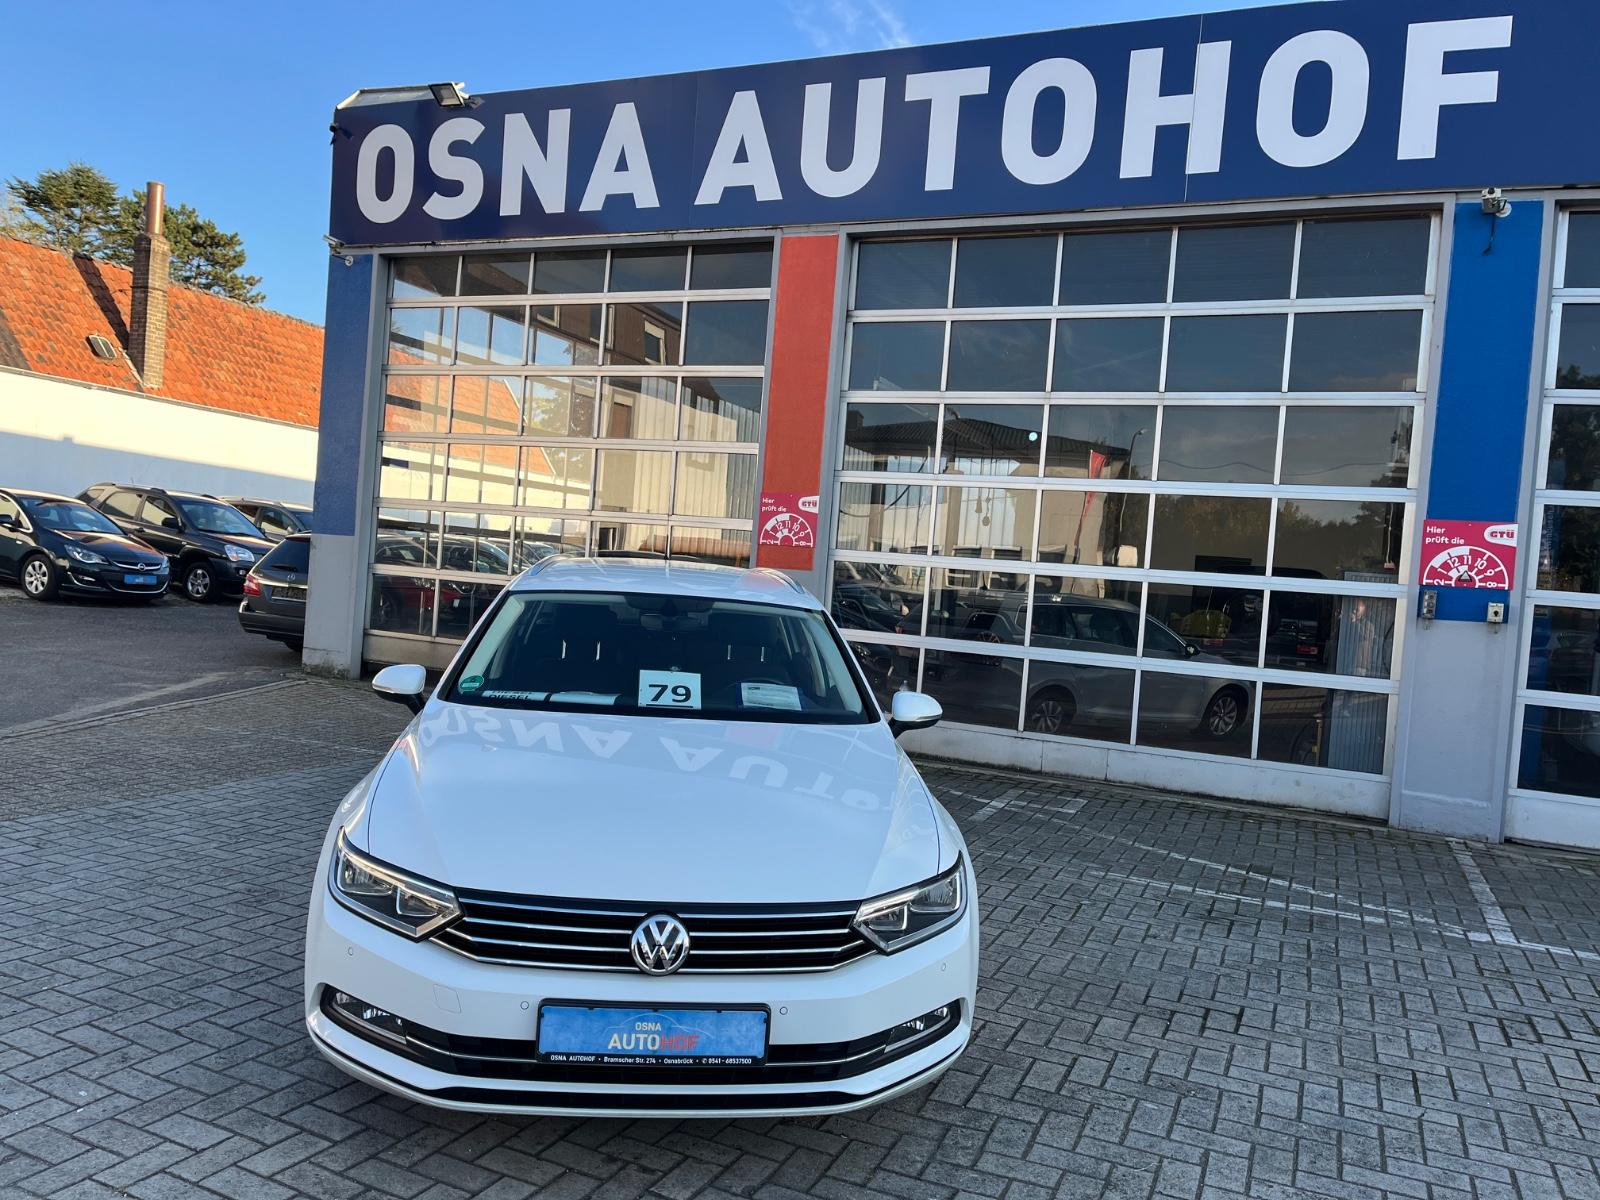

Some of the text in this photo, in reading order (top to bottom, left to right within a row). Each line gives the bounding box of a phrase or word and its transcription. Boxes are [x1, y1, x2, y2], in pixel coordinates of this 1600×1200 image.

[356, 16, 1513, 223] OSNA AUTOHOF
[775, 522, 784, 530] 12
[792, 523, 800, 531] 10
[1426, 526, 1446, 534] Hier
[1490, 530, 1514, 538] GTÜ
[1425, 536, 1449, 544] prüft
[1433, 578, 1445, 586] 2
[1447, 556, 1461, 568] 12
[1463, 555, 1472, 565] 11
[1474, 558, 1487, 570] 10
[649, 684, 692, 703] 79
[635, 1022, 662, 1032] OSNA
[608, 1034, 701, 1050] AUTOHOF
